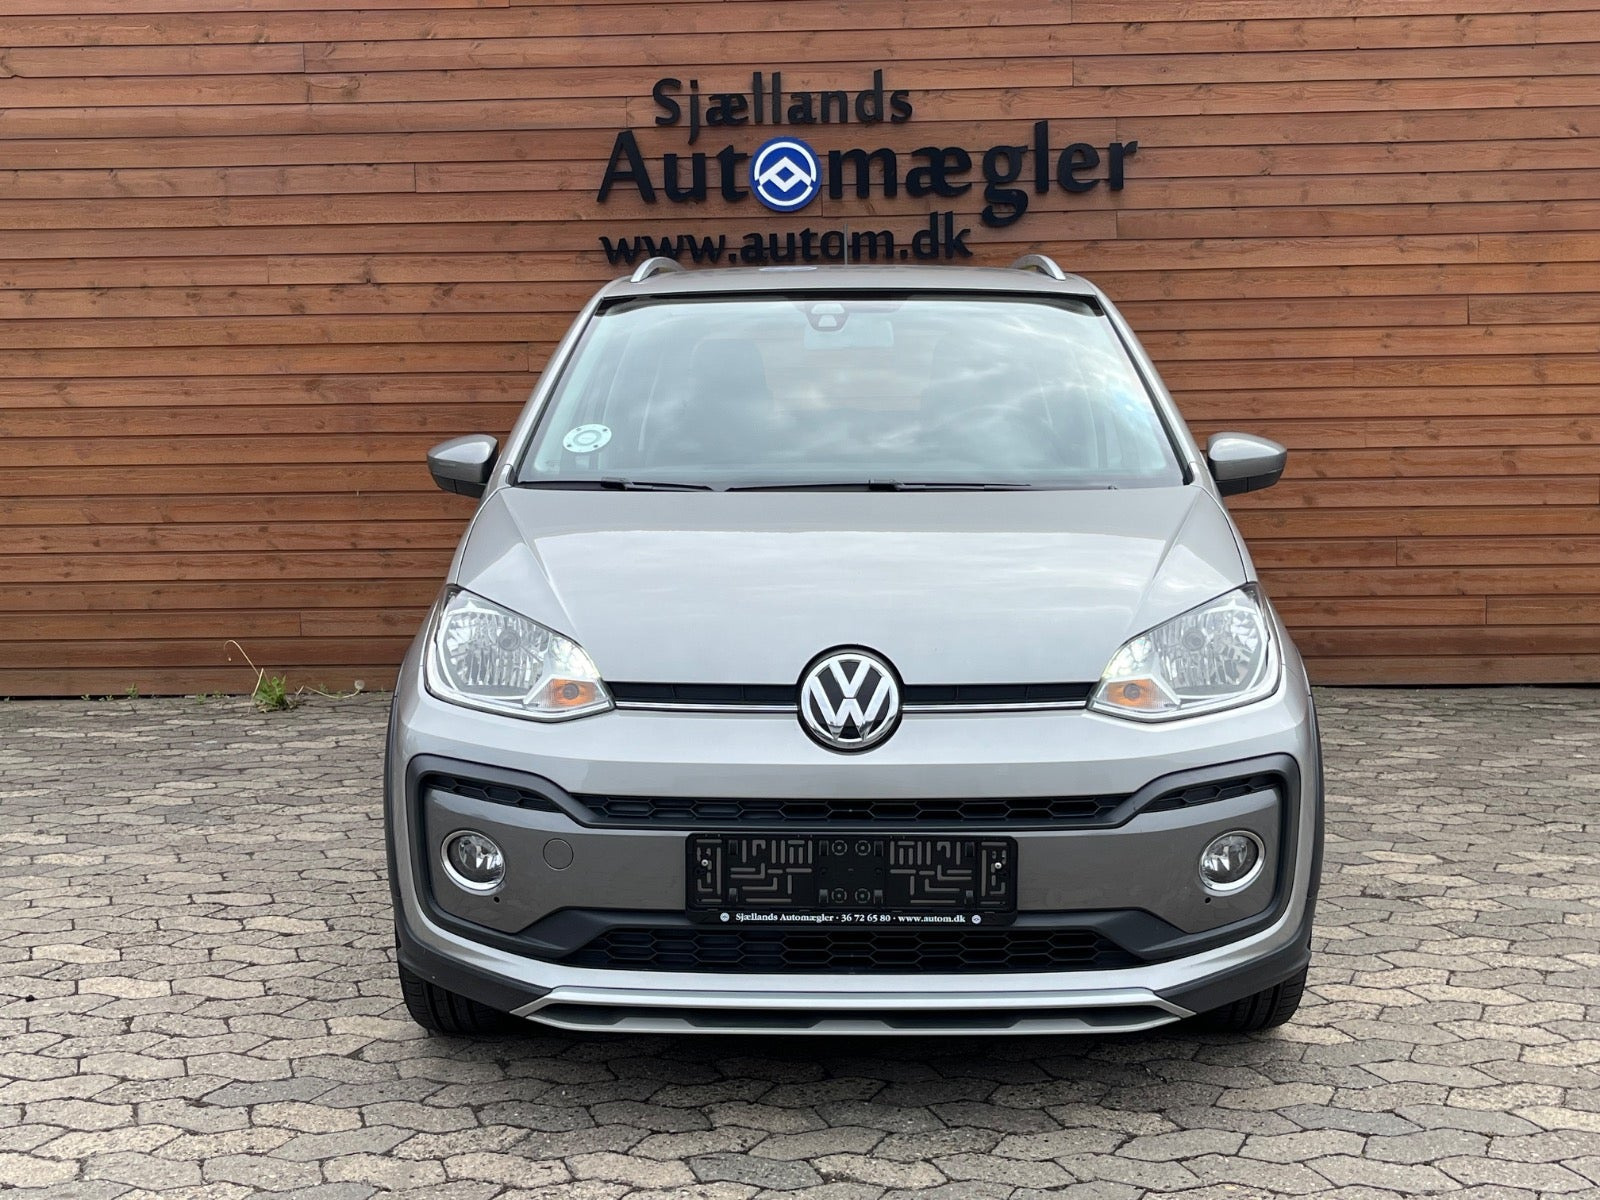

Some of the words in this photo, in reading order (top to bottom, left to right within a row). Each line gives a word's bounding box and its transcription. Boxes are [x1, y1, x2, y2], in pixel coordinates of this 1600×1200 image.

[652, 69, 912, 145] Sjællands
[599, 211, 972, 264] www.autom.dk
[735, 912, 778, 923] Sjællands
[779, 913, 834, 923] Automægler
[840, 913, 853, 922] 36
[853, 913, 865, 922] 72
[866, 913, 878, 922] 65
[879, 913, 891, 922] 80
[898, 914, 966, 923] www.autom.dk
